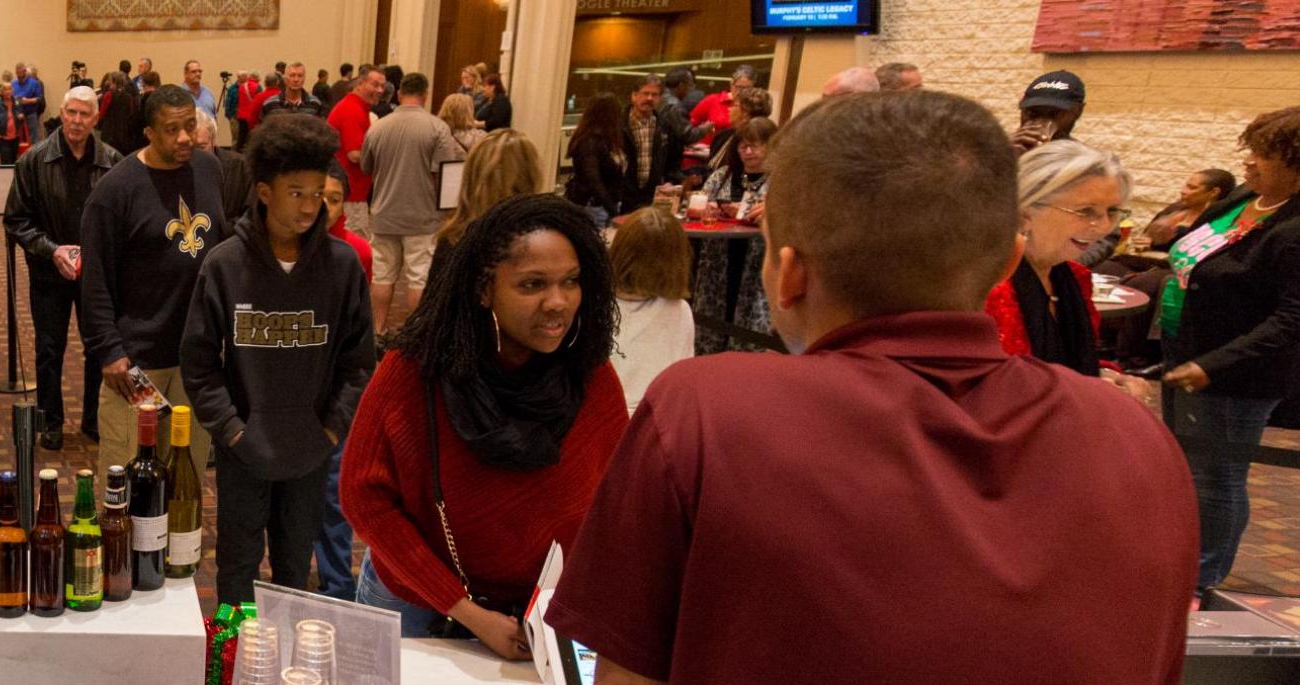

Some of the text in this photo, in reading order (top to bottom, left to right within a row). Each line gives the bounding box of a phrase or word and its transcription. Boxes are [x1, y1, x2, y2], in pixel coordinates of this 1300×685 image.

[802, 6, 825, 14] CELTIC
[826, 4, 854, 13] LEGACY
[234, 310, 314, 330] HOOPS
[234, 327, 329, 347] HAPPEN
